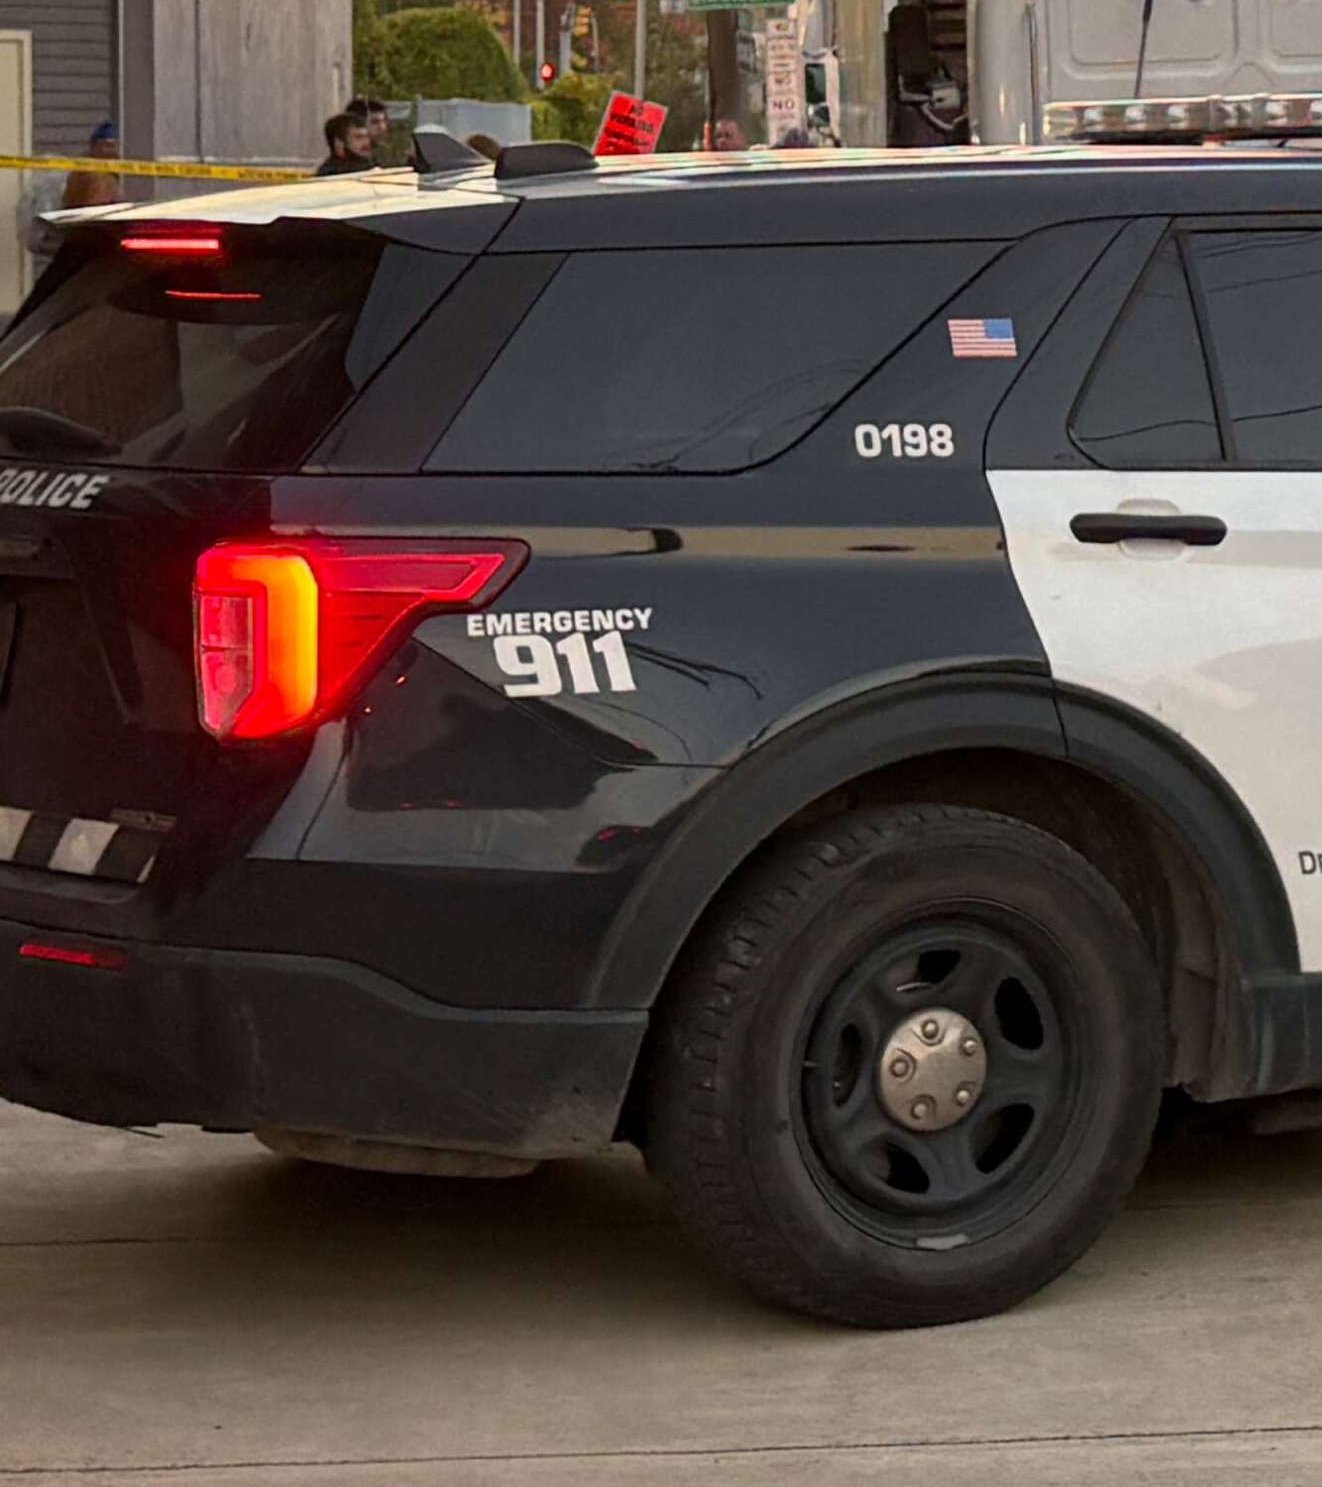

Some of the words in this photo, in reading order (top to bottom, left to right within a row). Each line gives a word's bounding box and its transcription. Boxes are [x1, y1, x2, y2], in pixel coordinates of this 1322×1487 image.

[772, 98, 795, 111] NO
[854, 423, 954, 457] 0198
[467, 607, 653, 637] EMERGENCY
[493, 629, 637, 698] 911
